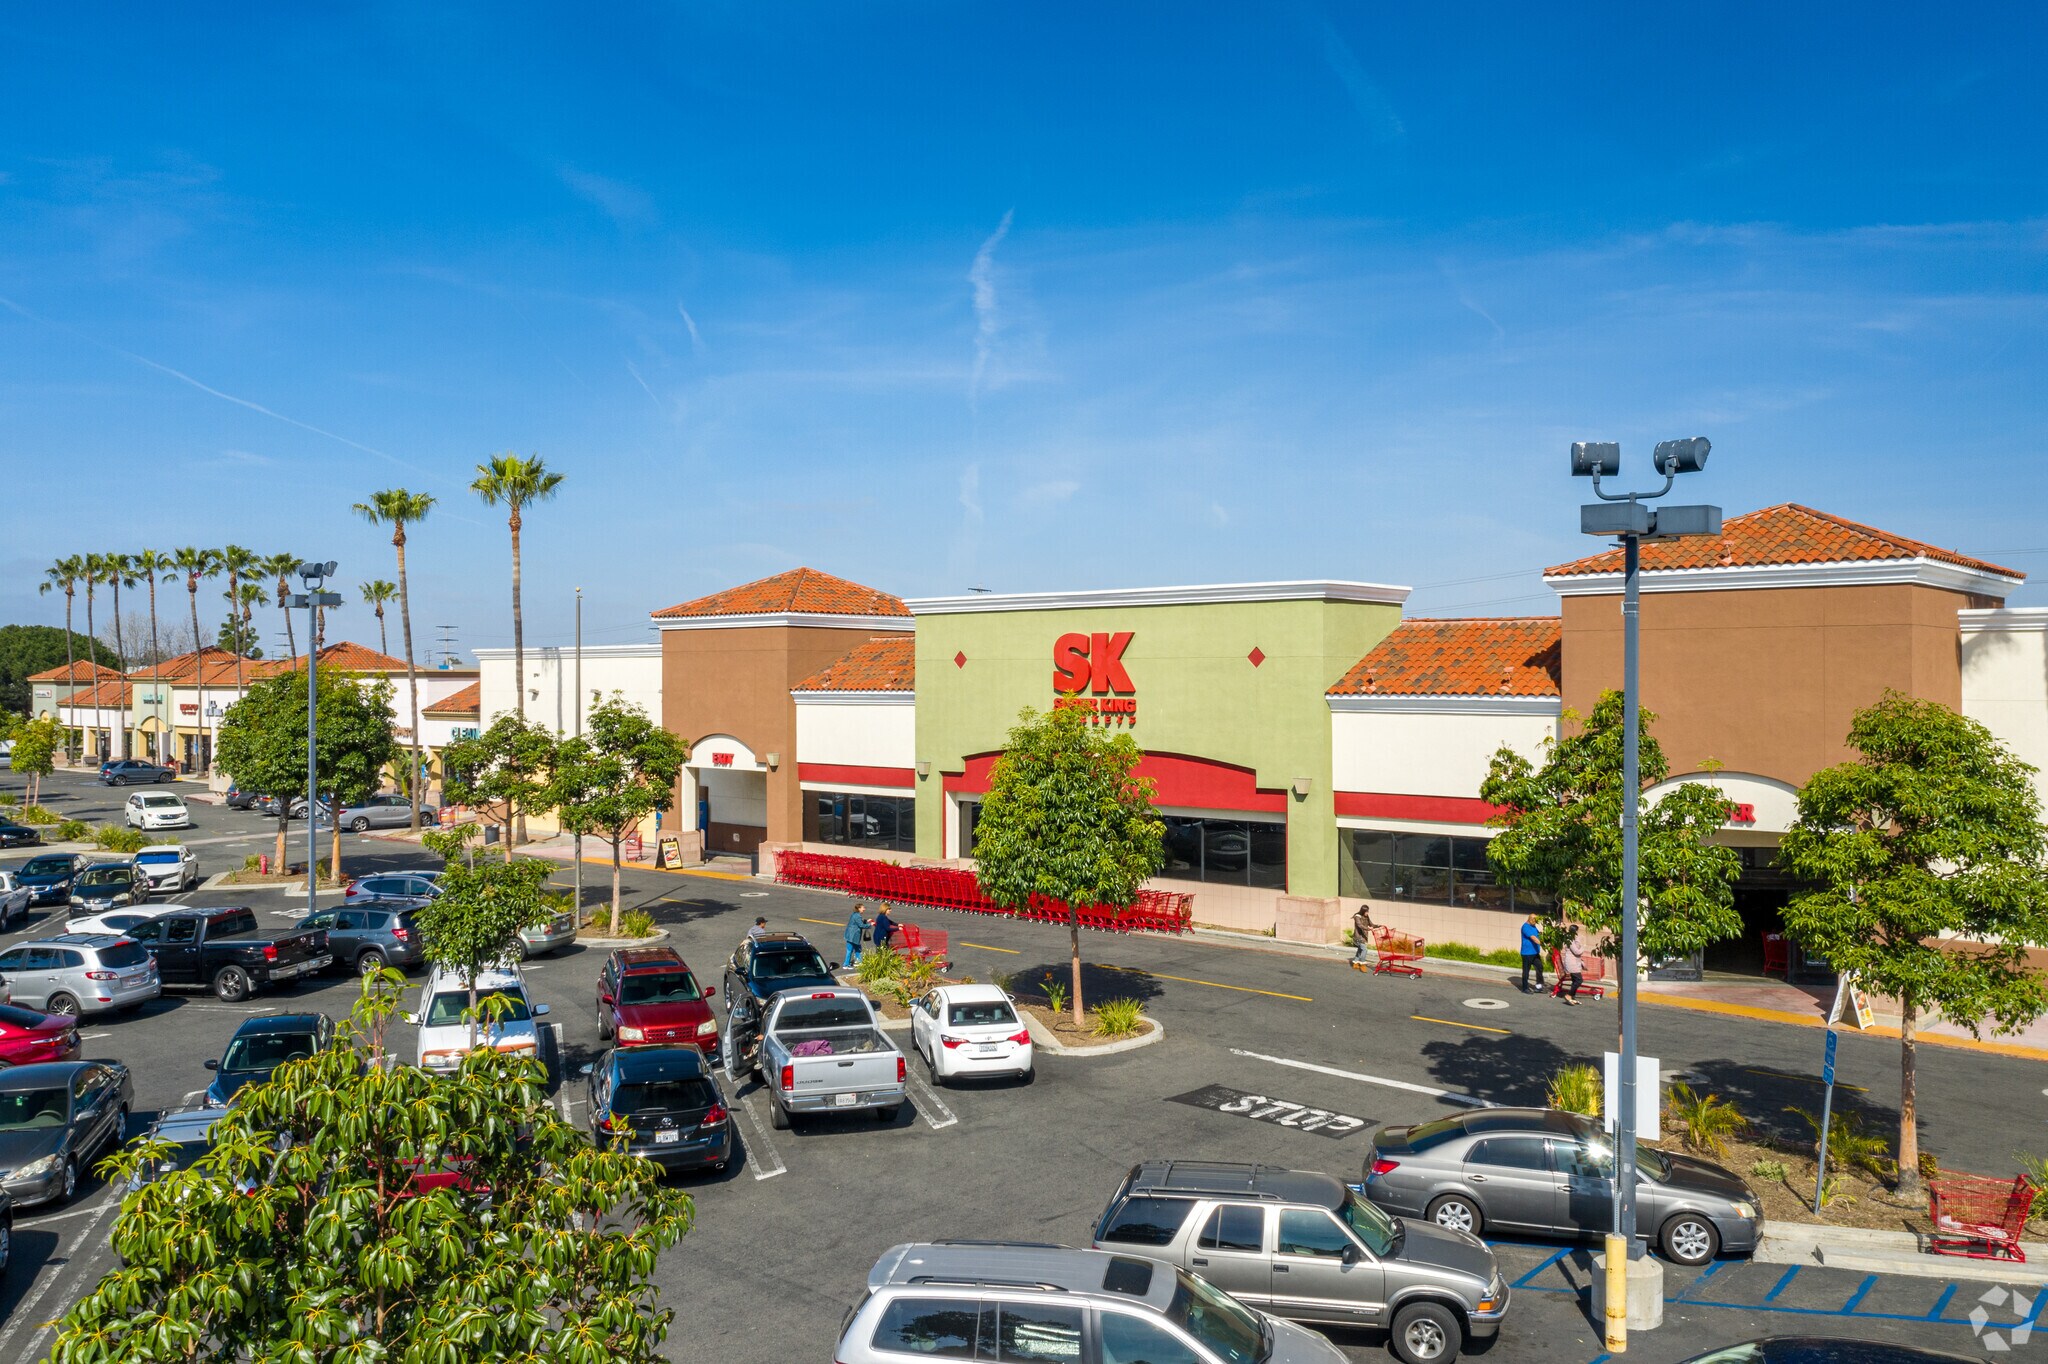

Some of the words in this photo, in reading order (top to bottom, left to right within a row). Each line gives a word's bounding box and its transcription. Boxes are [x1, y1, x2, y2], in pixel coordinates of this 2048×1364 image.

[1053, 632, 1136, 693] SK
[1100, 698, 1136, 712] KING
[451, 726, 480, 740] CLEAN
[1219, 1096, 1365, 1132] STOP
